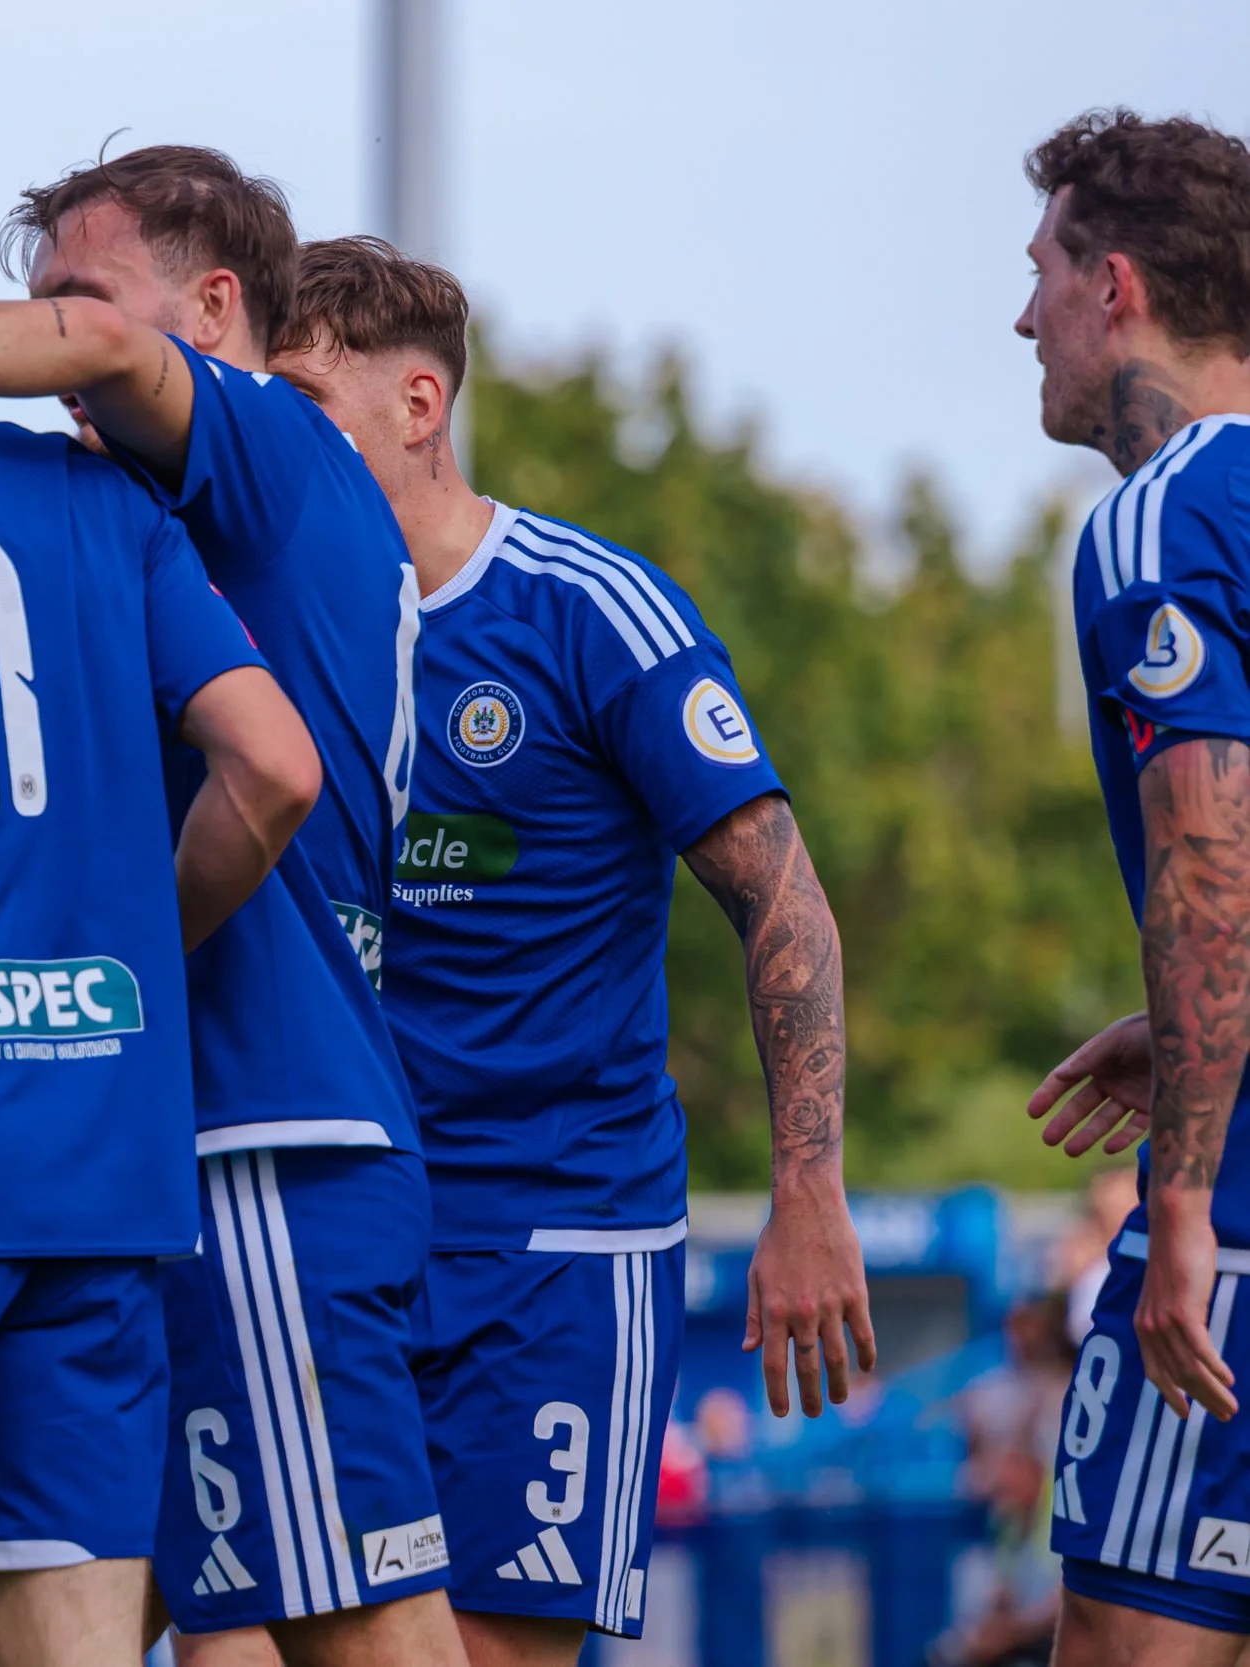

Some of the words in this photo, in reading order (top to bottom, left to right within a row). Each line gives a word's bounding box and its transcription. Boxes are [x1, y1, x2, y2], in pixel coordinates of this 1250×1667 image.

[453, 687, 485, 717] CURZON
[487, 687, 518, 716] ASHTON
[706, 703, 745, 742] E
[453, 735, 494, 760] FOOTBALL
[497, 734, 517, 755] CLUB
[392, 883, 474, 908] Supplies
[1063, 1334, 1120, 1461] 8
[185, 1406, 242, 1533] 6
[526, 1401, 590, 1525] 3
[413, 1530, 443, 1550] AZTEK
